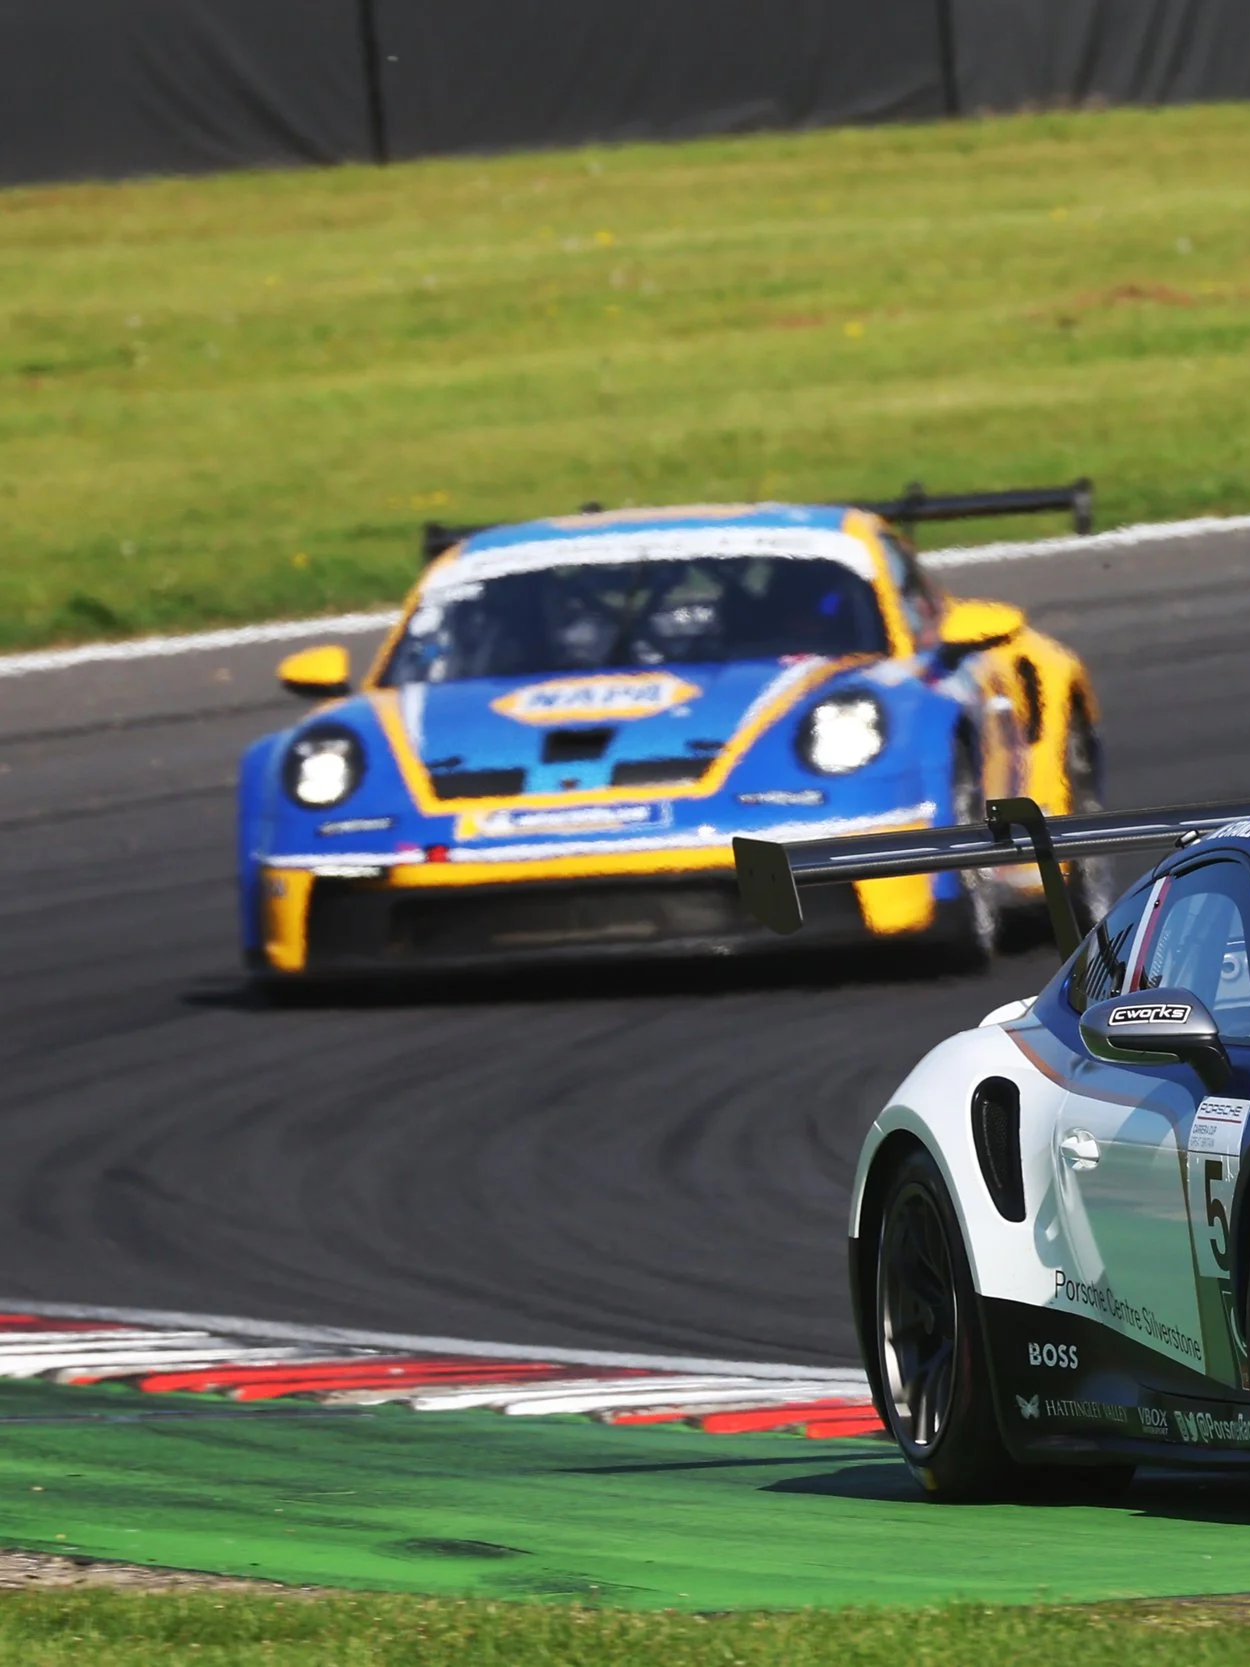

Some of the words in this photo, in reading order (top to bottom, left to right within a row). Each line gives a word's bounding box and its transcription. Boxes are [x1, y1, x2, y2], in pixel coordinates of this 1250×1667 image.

[1114, 1005, 1186, 1020] cworks
[1205, 1159, 1231, 1272] 5
[1055, 1270, 1107, 1312] Porsche
[1106, 1288, 1142, 1330] Centre
[1142, 1307, 1202, 1361] Silverstone
[1028, 1342, 1078, 1370] BOSS
[1137, 1407, 1168, 1427] VBOX
